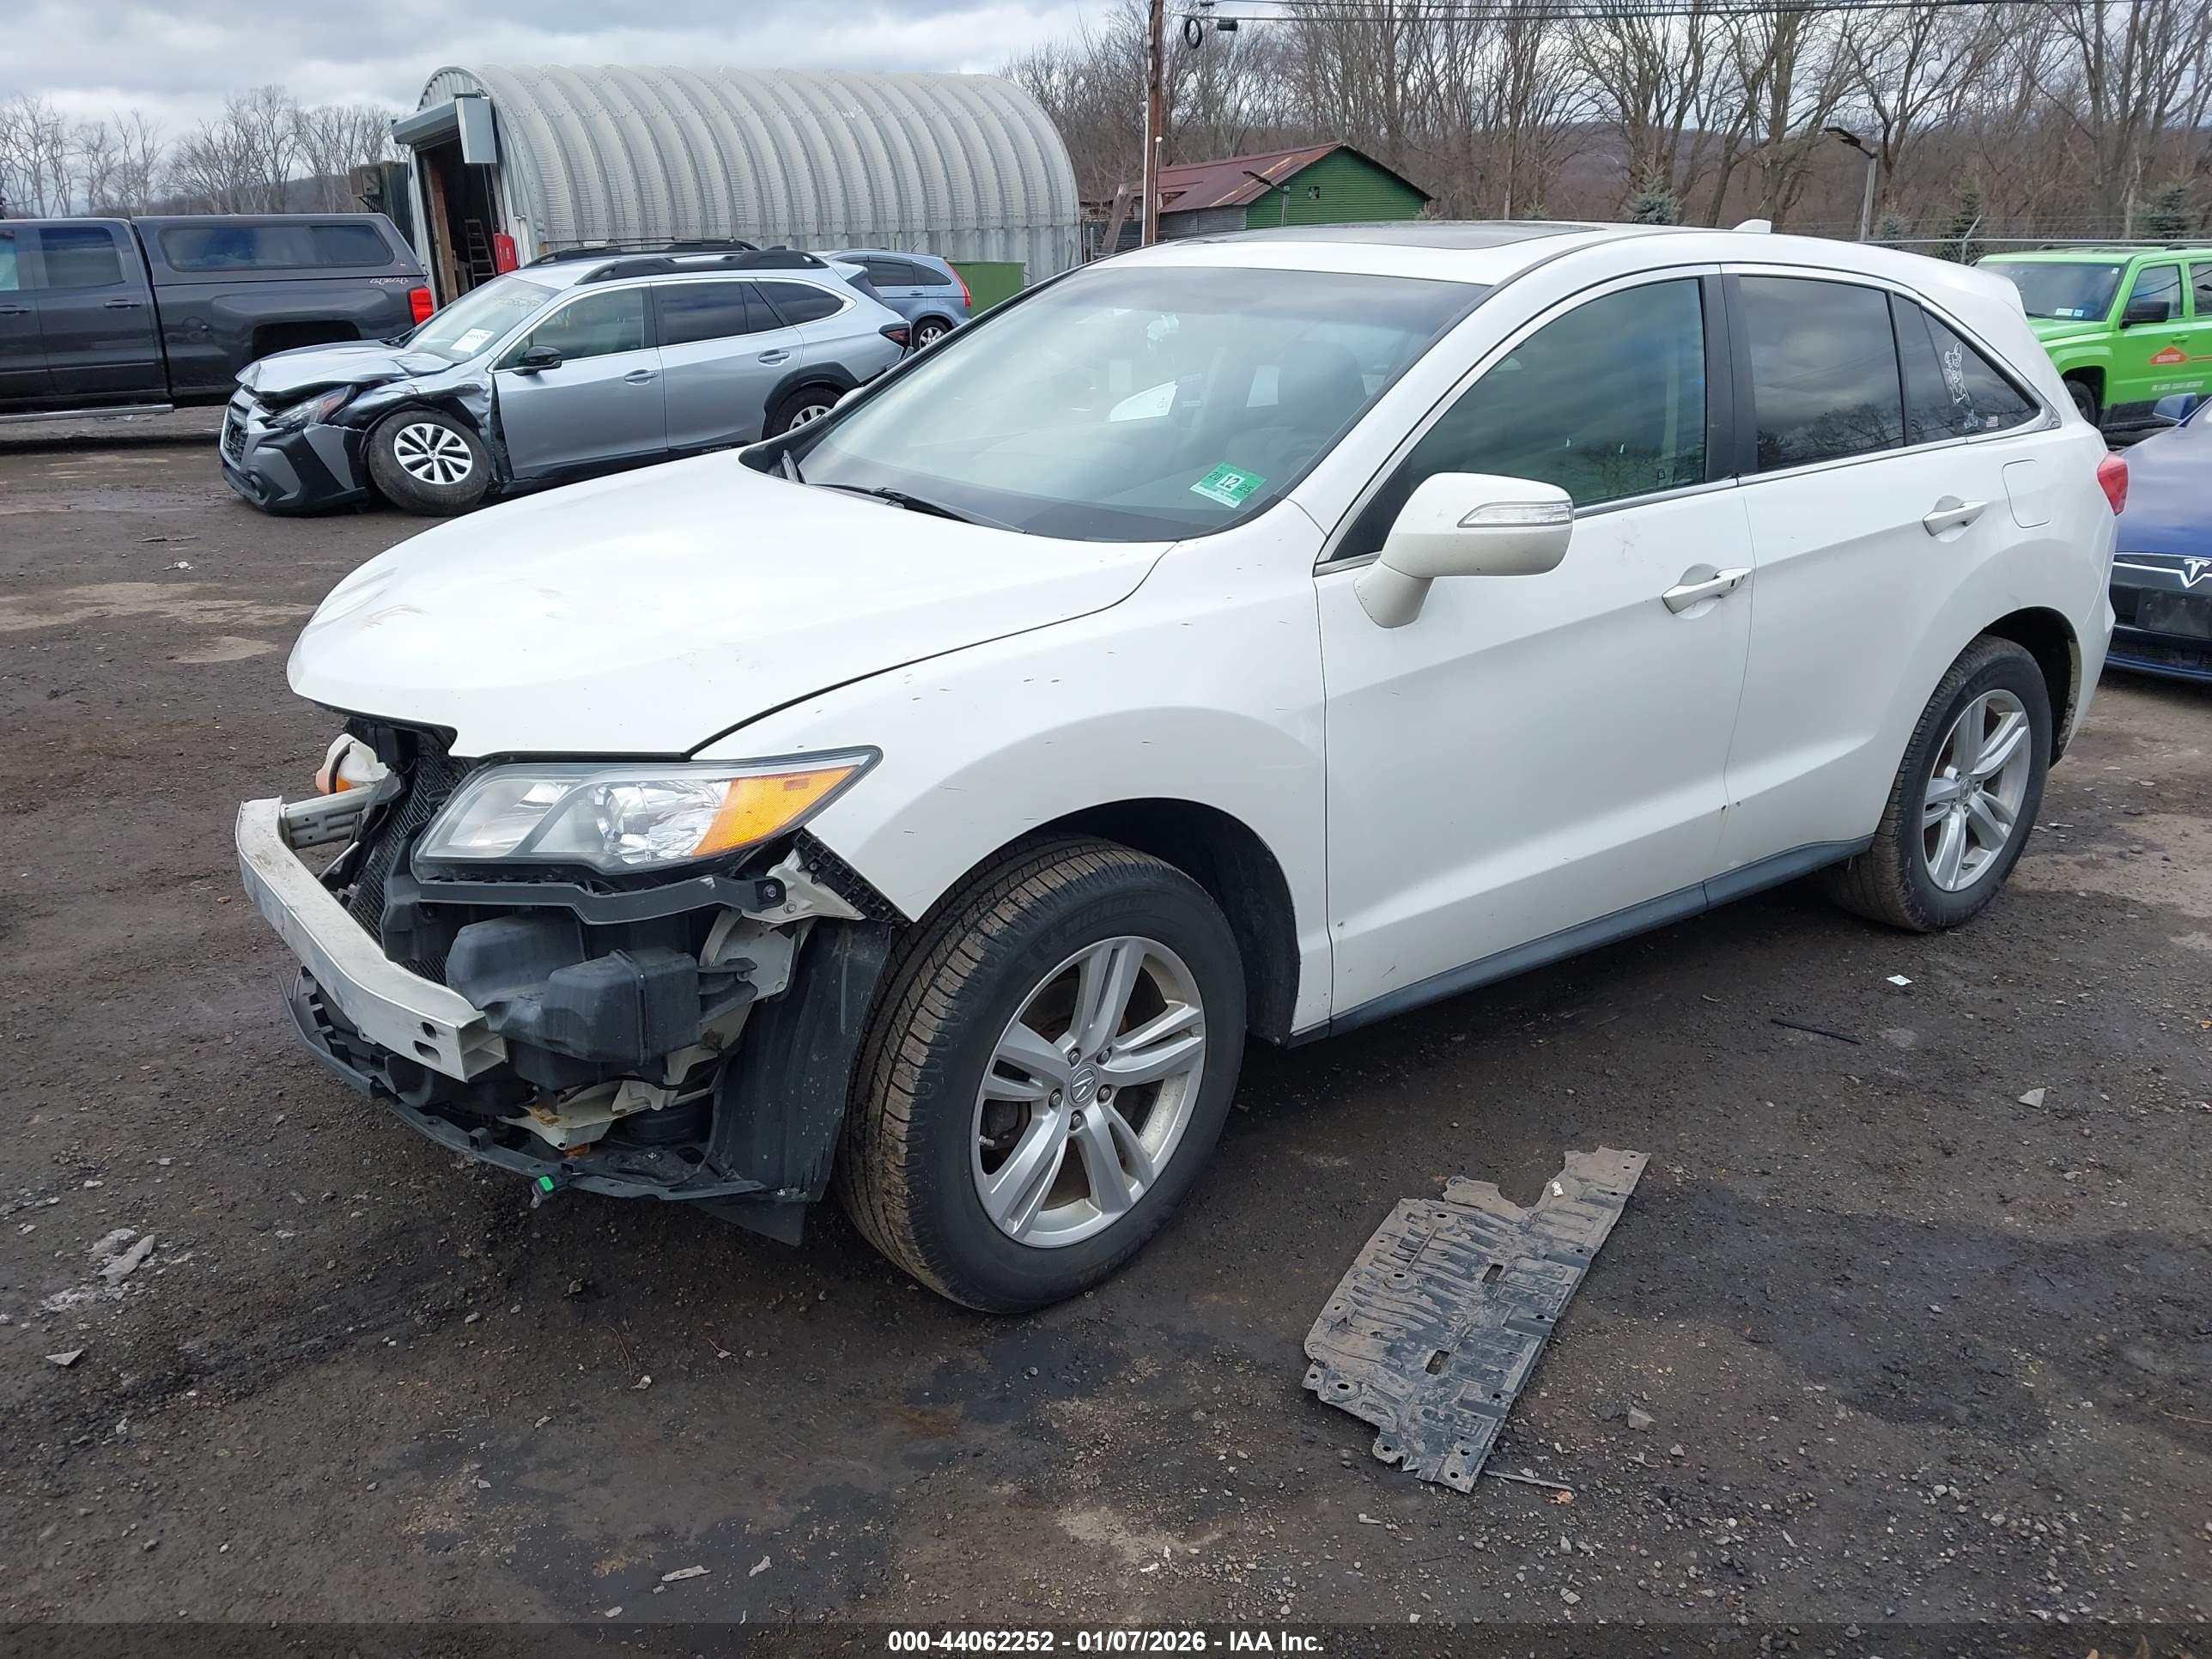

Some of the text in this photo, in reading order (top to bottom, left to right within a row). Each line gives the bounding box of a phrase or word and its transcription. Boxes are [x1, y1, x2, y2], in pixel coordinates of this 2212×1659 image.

[1208, 471, 1224, 481] 20
[1219, 475, 1241, 489] 12
[1237, 483, 1255, 495] 25
